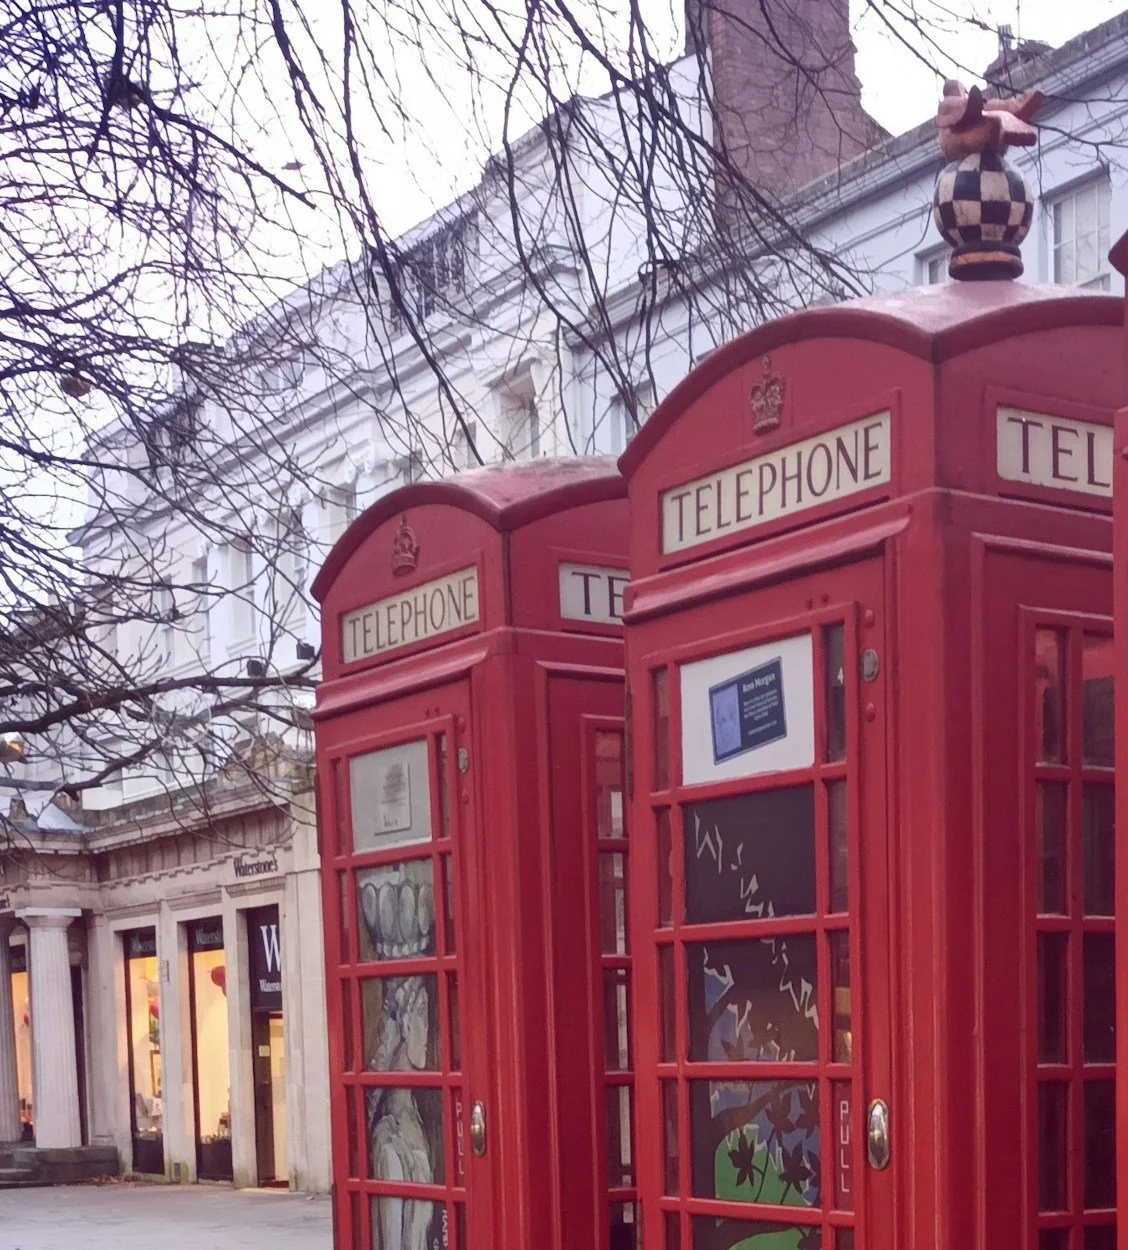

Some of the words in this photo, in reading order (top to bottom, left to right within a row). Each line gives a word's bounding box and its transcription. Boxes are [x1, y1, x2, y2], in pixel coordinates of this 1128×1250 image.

[671, 421, 884, 542] TELEPHONE
[1007, 416, 1111, 488] TEL
[349, 576, 476, 657] TELEPHONE
[572, 571, 630, 618] TE
[233, 854, 278, 878] Waterstone's
[260, 925, 280, 972] W
[456, 1102, 465, 1175] PULL
[840, 1101, 850, 1193] PULL
